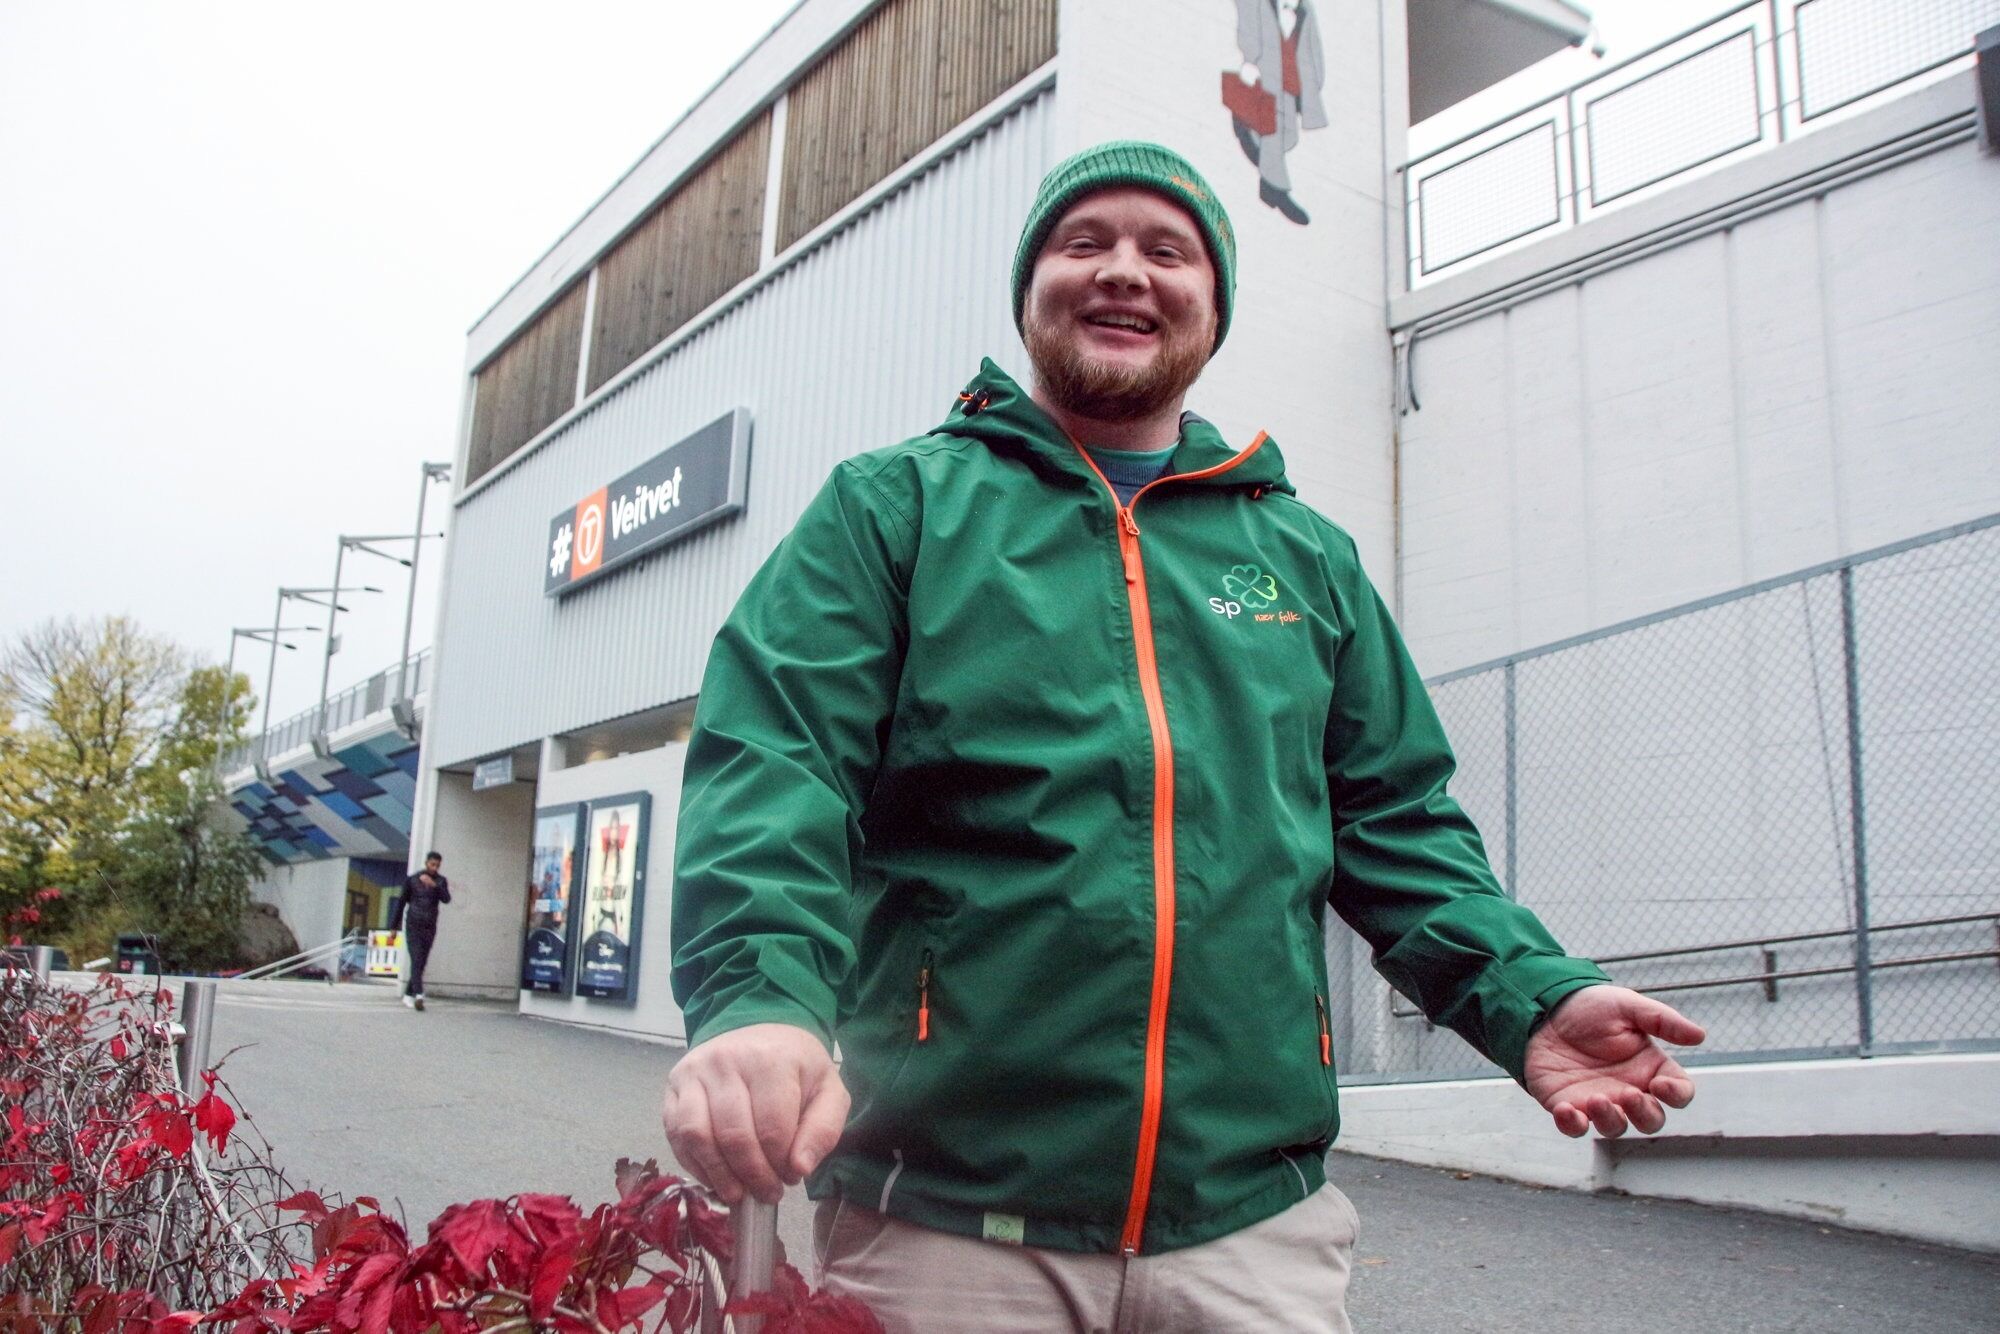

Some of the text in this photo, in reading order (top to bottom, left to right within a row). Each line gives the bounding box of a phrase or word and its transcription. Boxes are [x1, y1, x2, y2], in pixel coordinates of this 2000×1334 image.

[611, 465, 683, 541] Veitvet
[1208, 597, 1241, 619] Sp
[1278, 610, 1302, 626] folk
